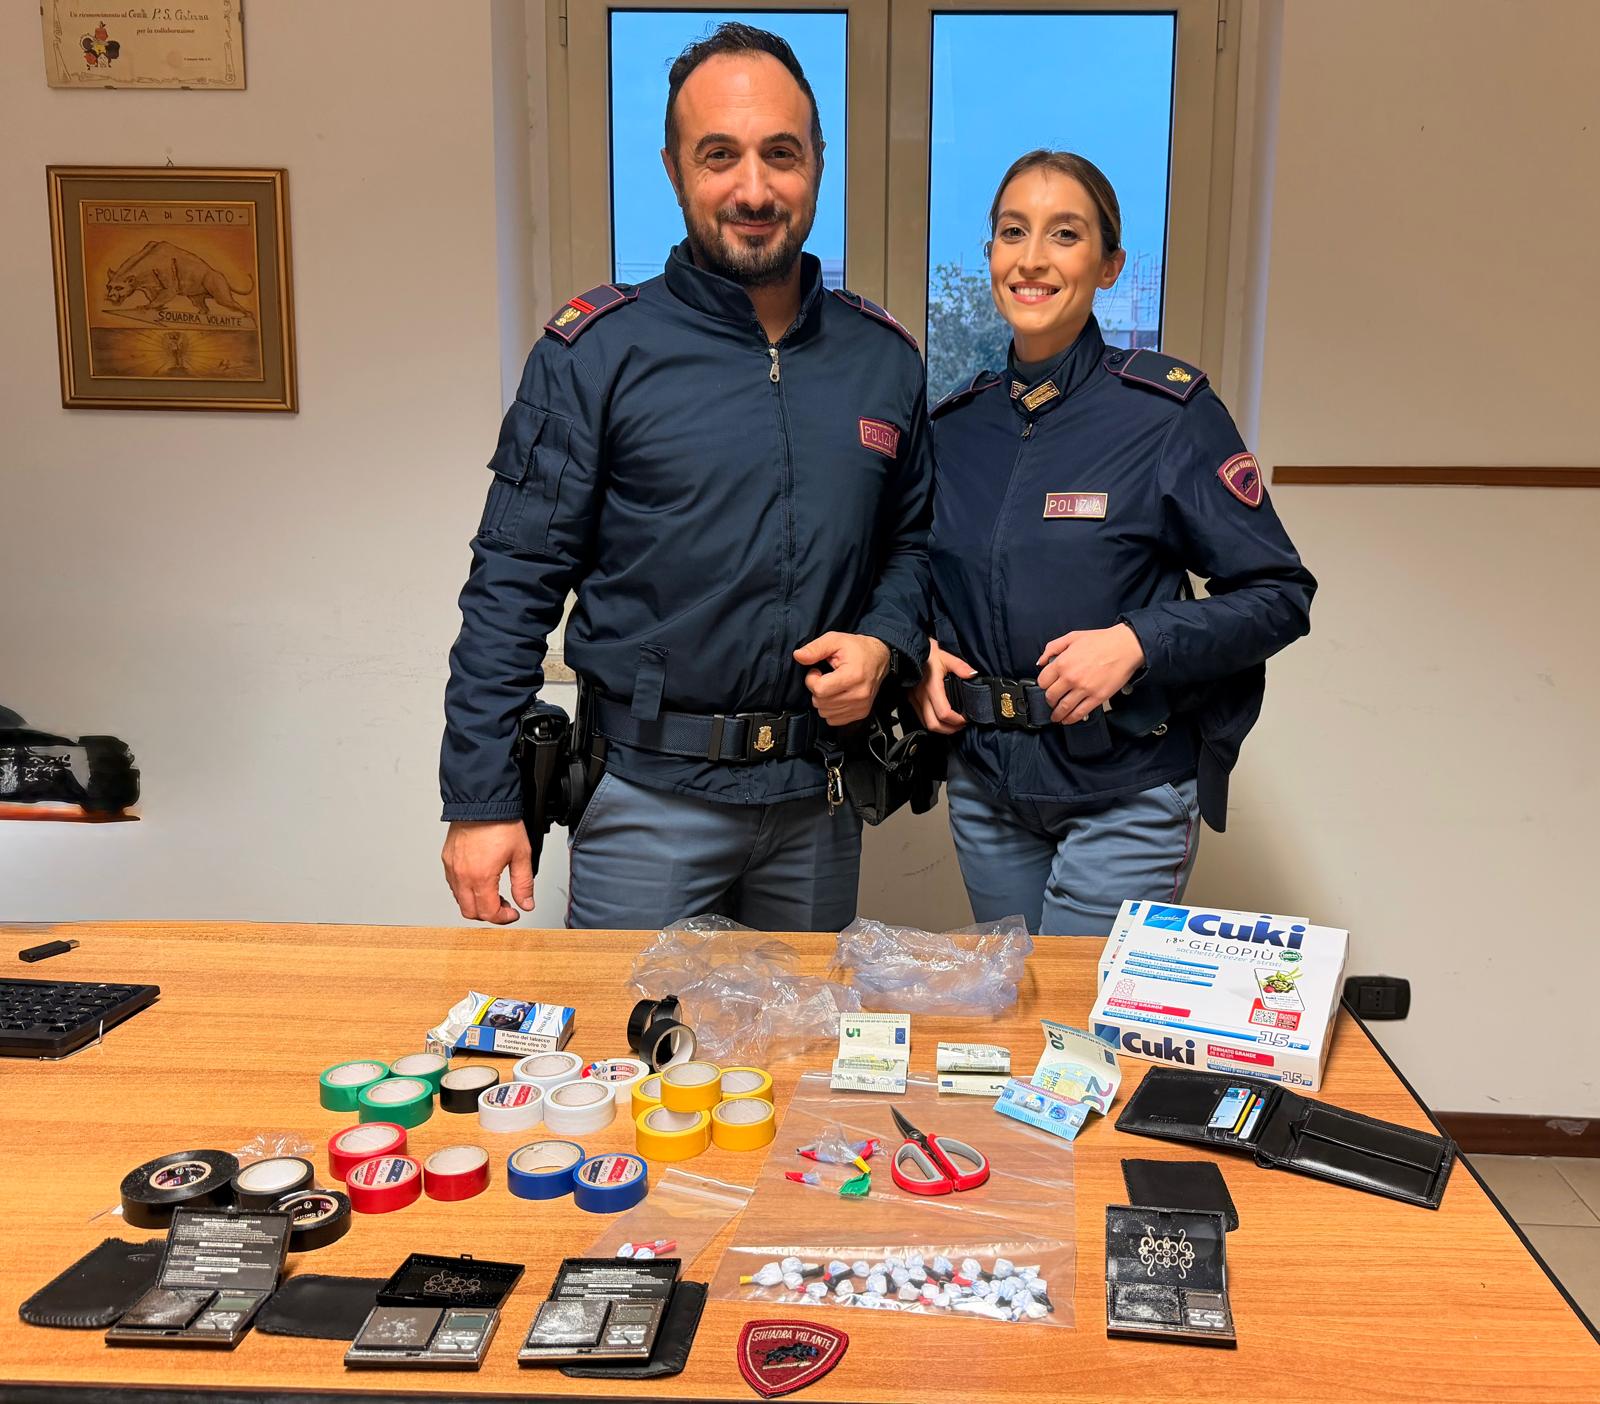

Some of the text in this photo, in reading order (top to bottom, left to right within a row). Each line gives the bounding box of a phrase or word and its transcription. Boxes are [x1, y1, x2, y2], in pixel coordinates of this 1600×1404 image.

[158, 311, 242, 327] SQUADRA VOLANTE
[1048, 498, 1102, 513] POLIZIA
[1187, 913, 1306, 950] Cuki
[1188, 939, 1275, 961] GELOPIÙ
[845, 1027, 861, 1038] 5
[1048, 1030, 1065, 1051] 20
[1258, 1030, 1290, 1048] 15
[1121, 1031, 1196, 1066] Cuki
[1209, 1045, 1257, 1059] FORMATO GRANDE
[1282, 1070, 1304, 1085] 15
[752, 1329, 833, 1350] SQUADRA VOLANTE
